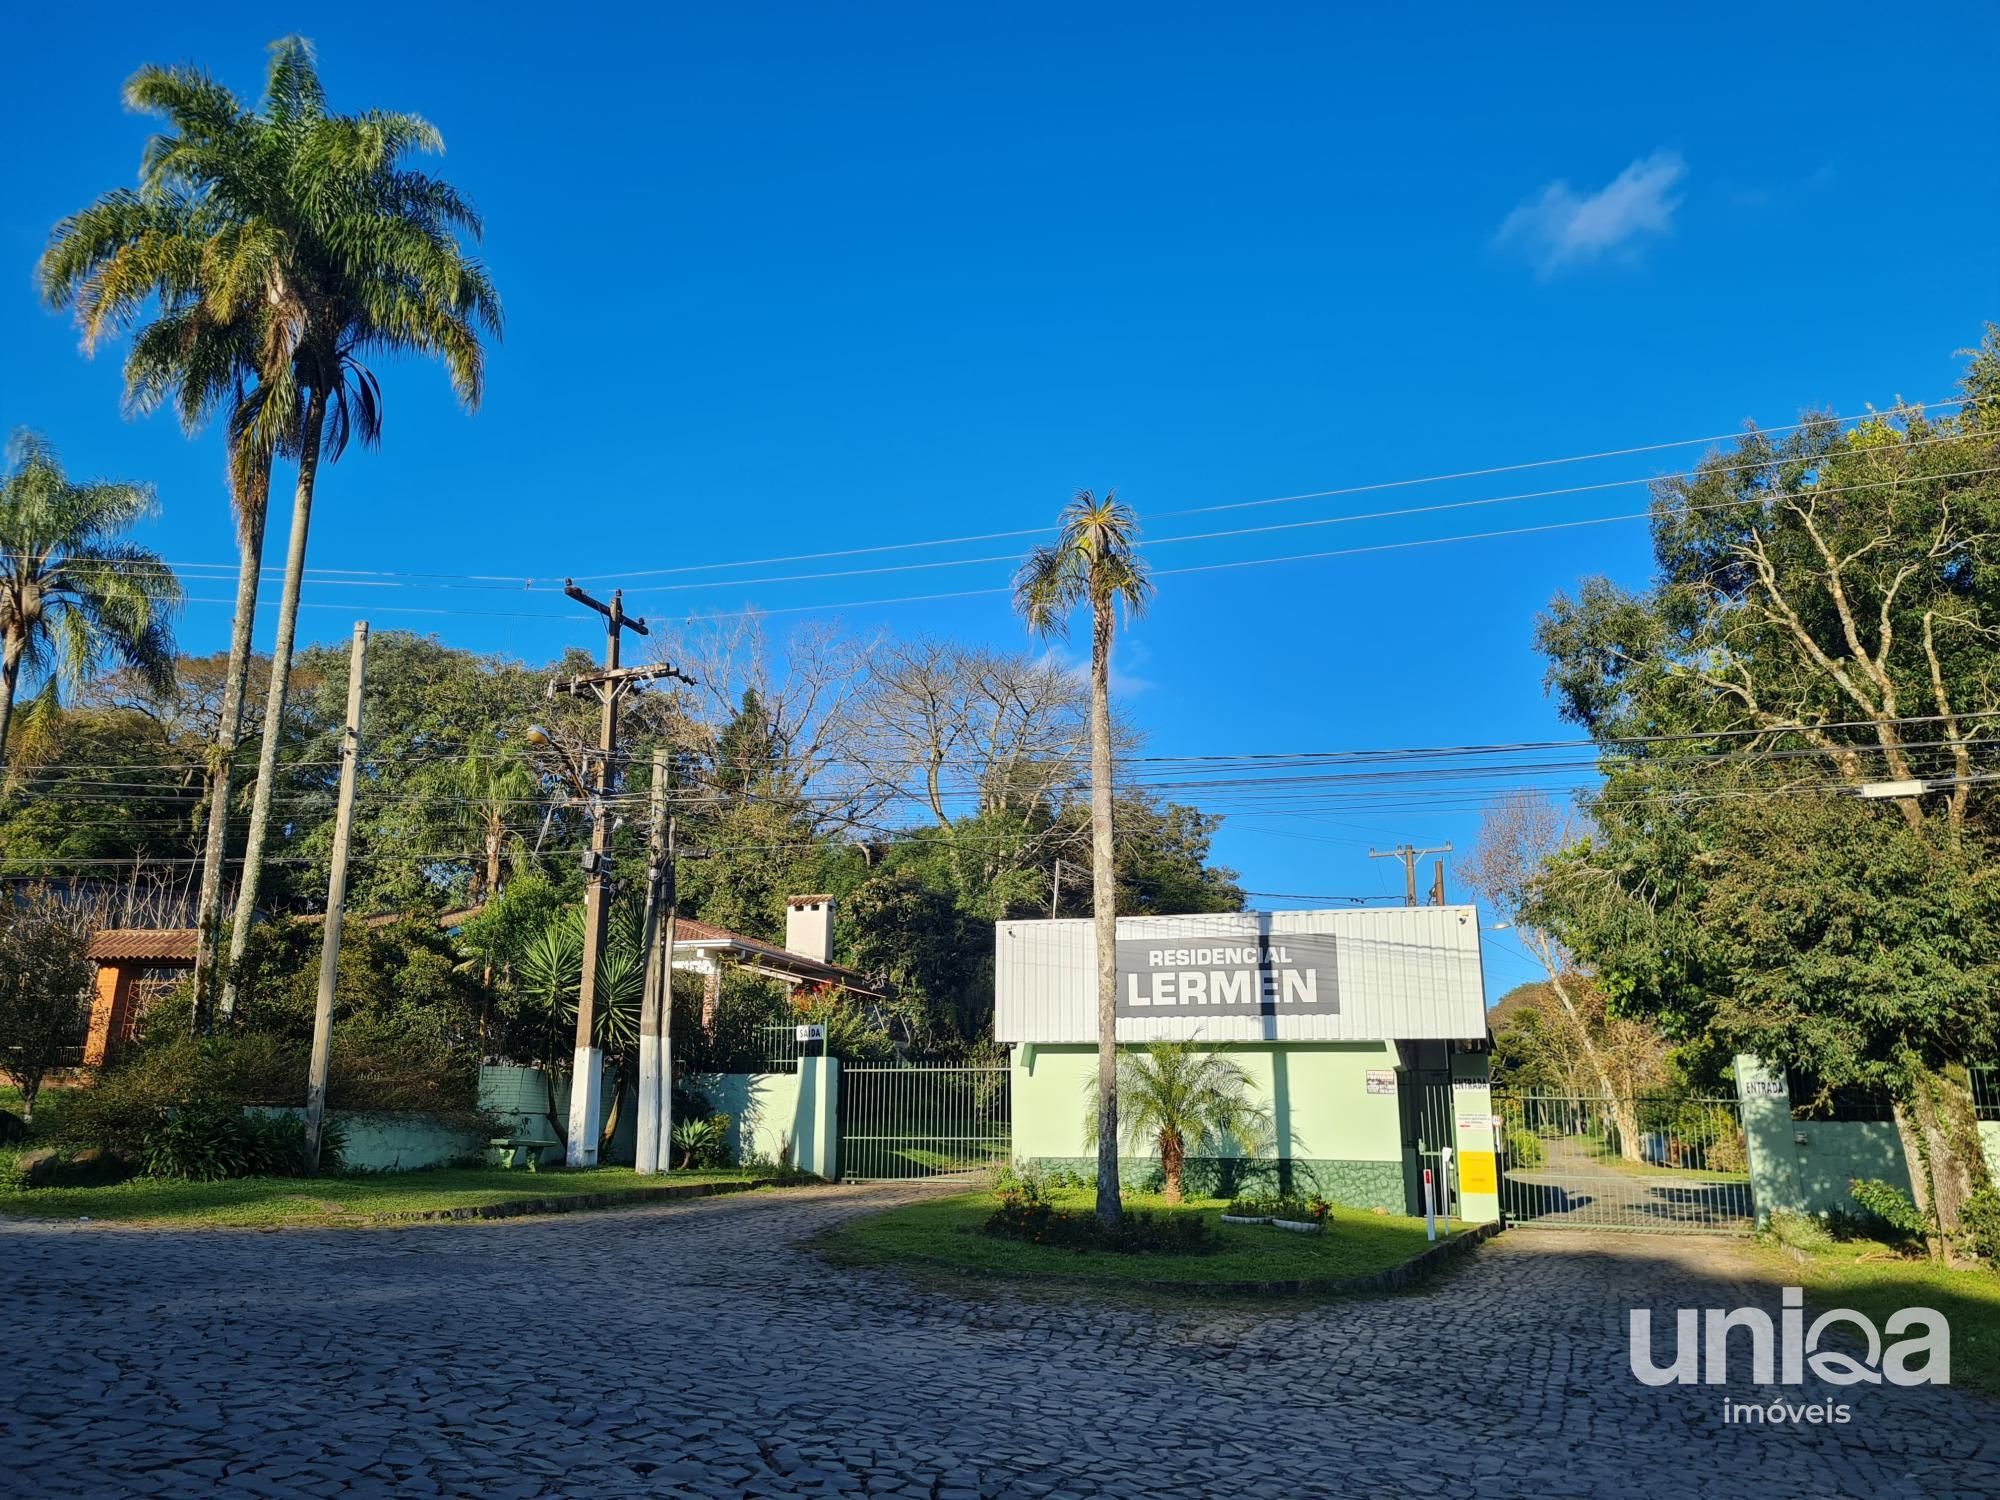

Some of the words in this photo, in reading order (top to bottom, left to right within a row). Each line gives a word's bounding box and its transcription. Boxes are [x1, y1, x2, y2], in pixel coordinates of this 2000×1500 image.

[1149, 946, 1293, 967] RESIDENCIAL
[1127, 968, 1318, 1007] LERMEN
[1454, 1078, 1487, 1090] ENTRADA
[1745, 1081, 1784, 1095] ENTRADA
